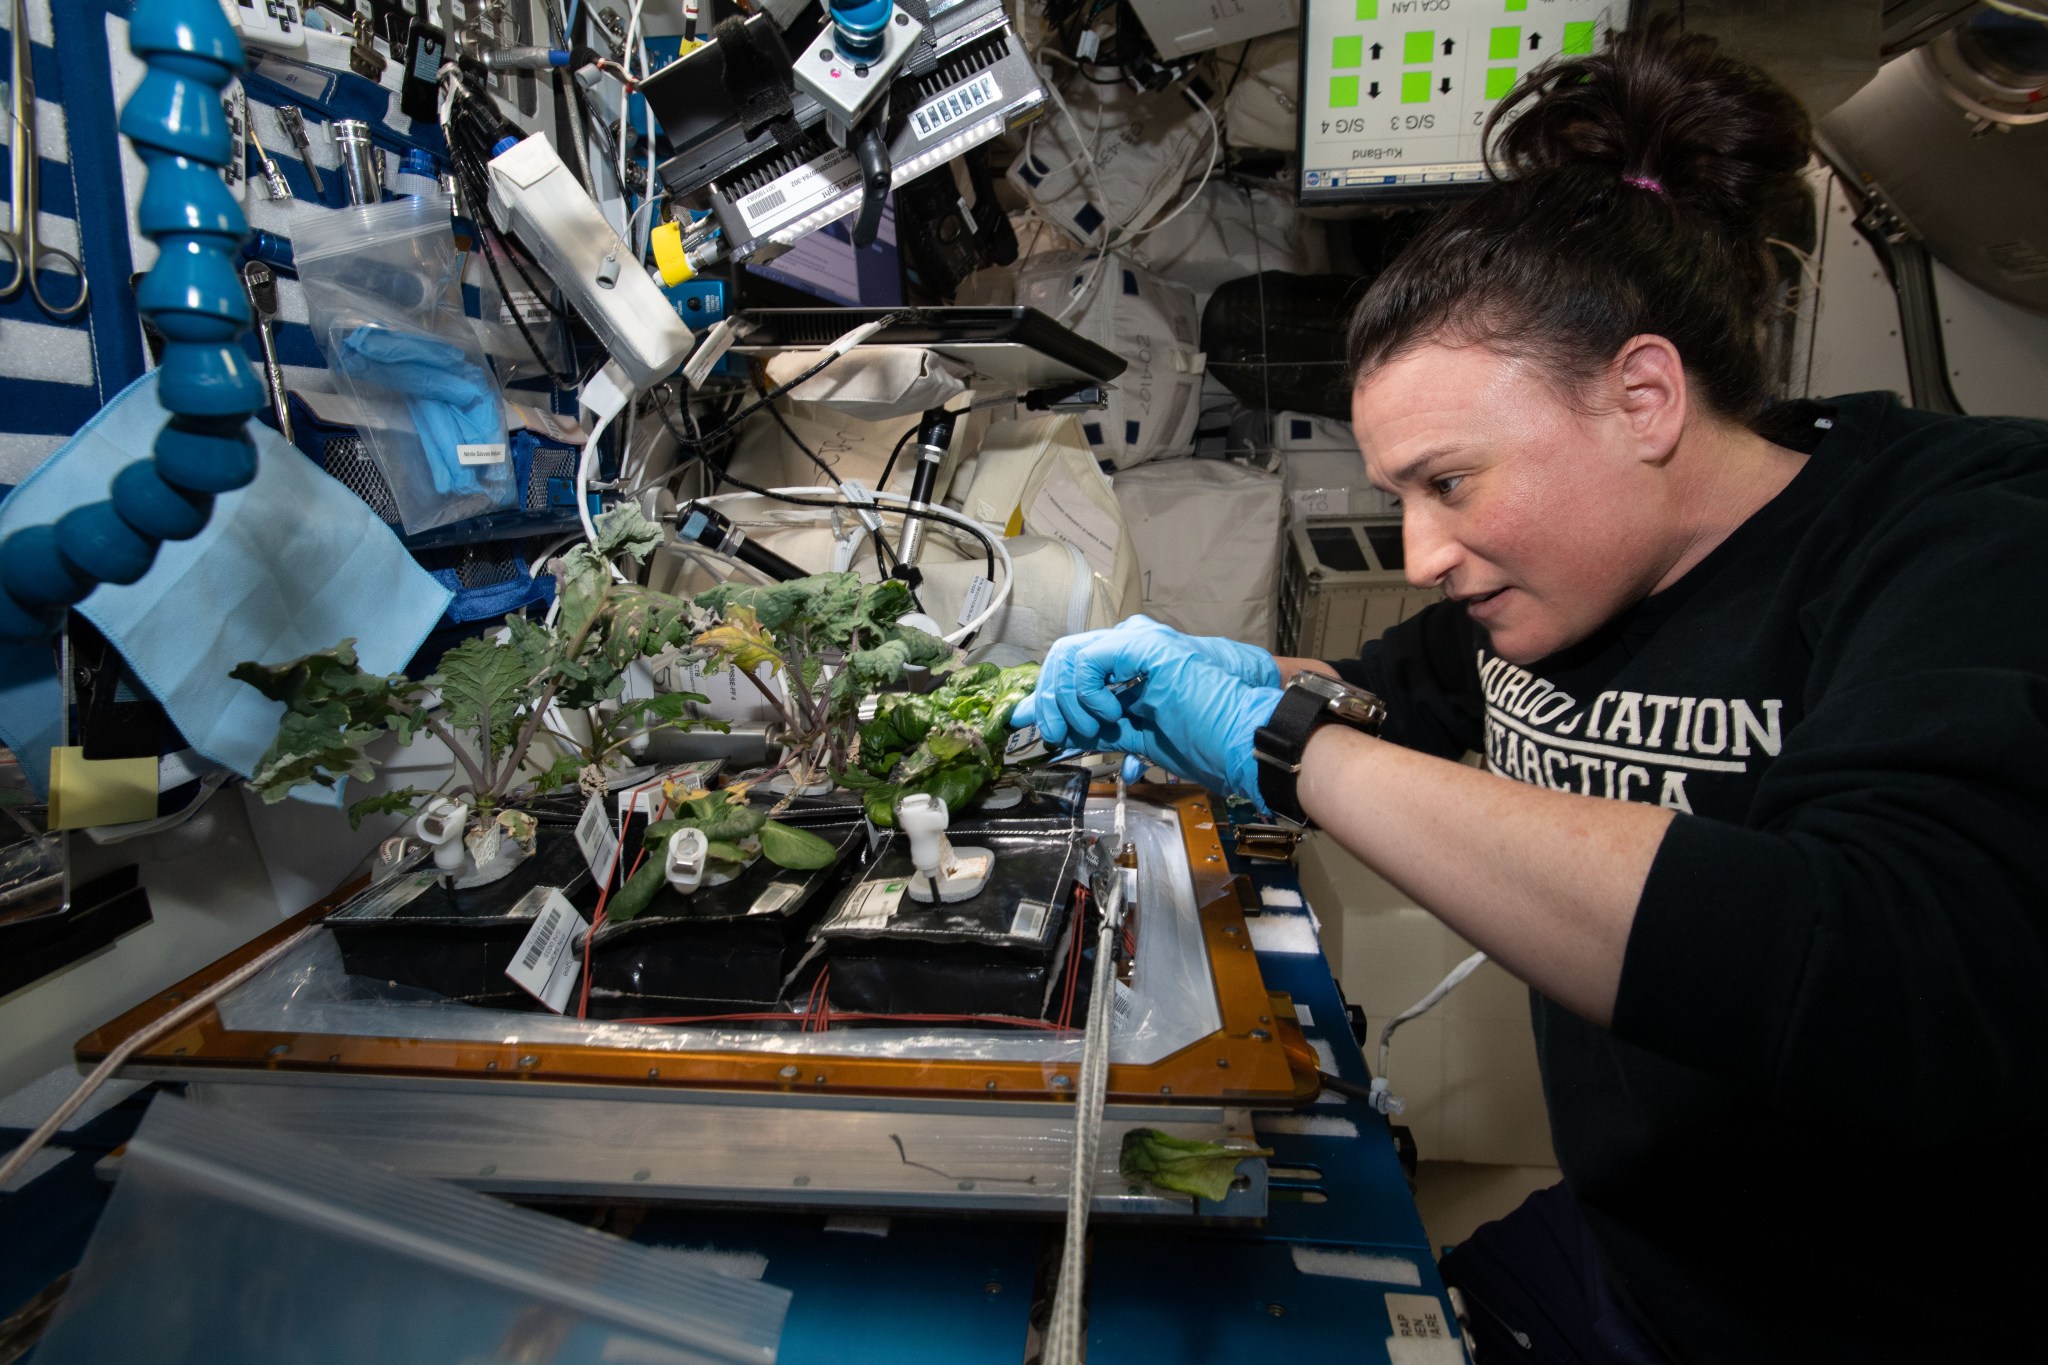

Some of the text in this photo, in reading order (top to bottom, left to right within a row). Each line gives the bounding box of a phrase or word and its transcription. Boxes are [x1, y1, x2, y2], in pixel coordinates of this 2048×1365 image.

[1391, 1, 1417, 14] LAN
[1390, 114, 1436, 131] S/G 3
[1473, 111, 1484, 126] 2
[1321, 118, 1365, 135] S/G 4
[1352, 147, 1403, 161] Ku-Band
[820, 182, 842, 198] Light
